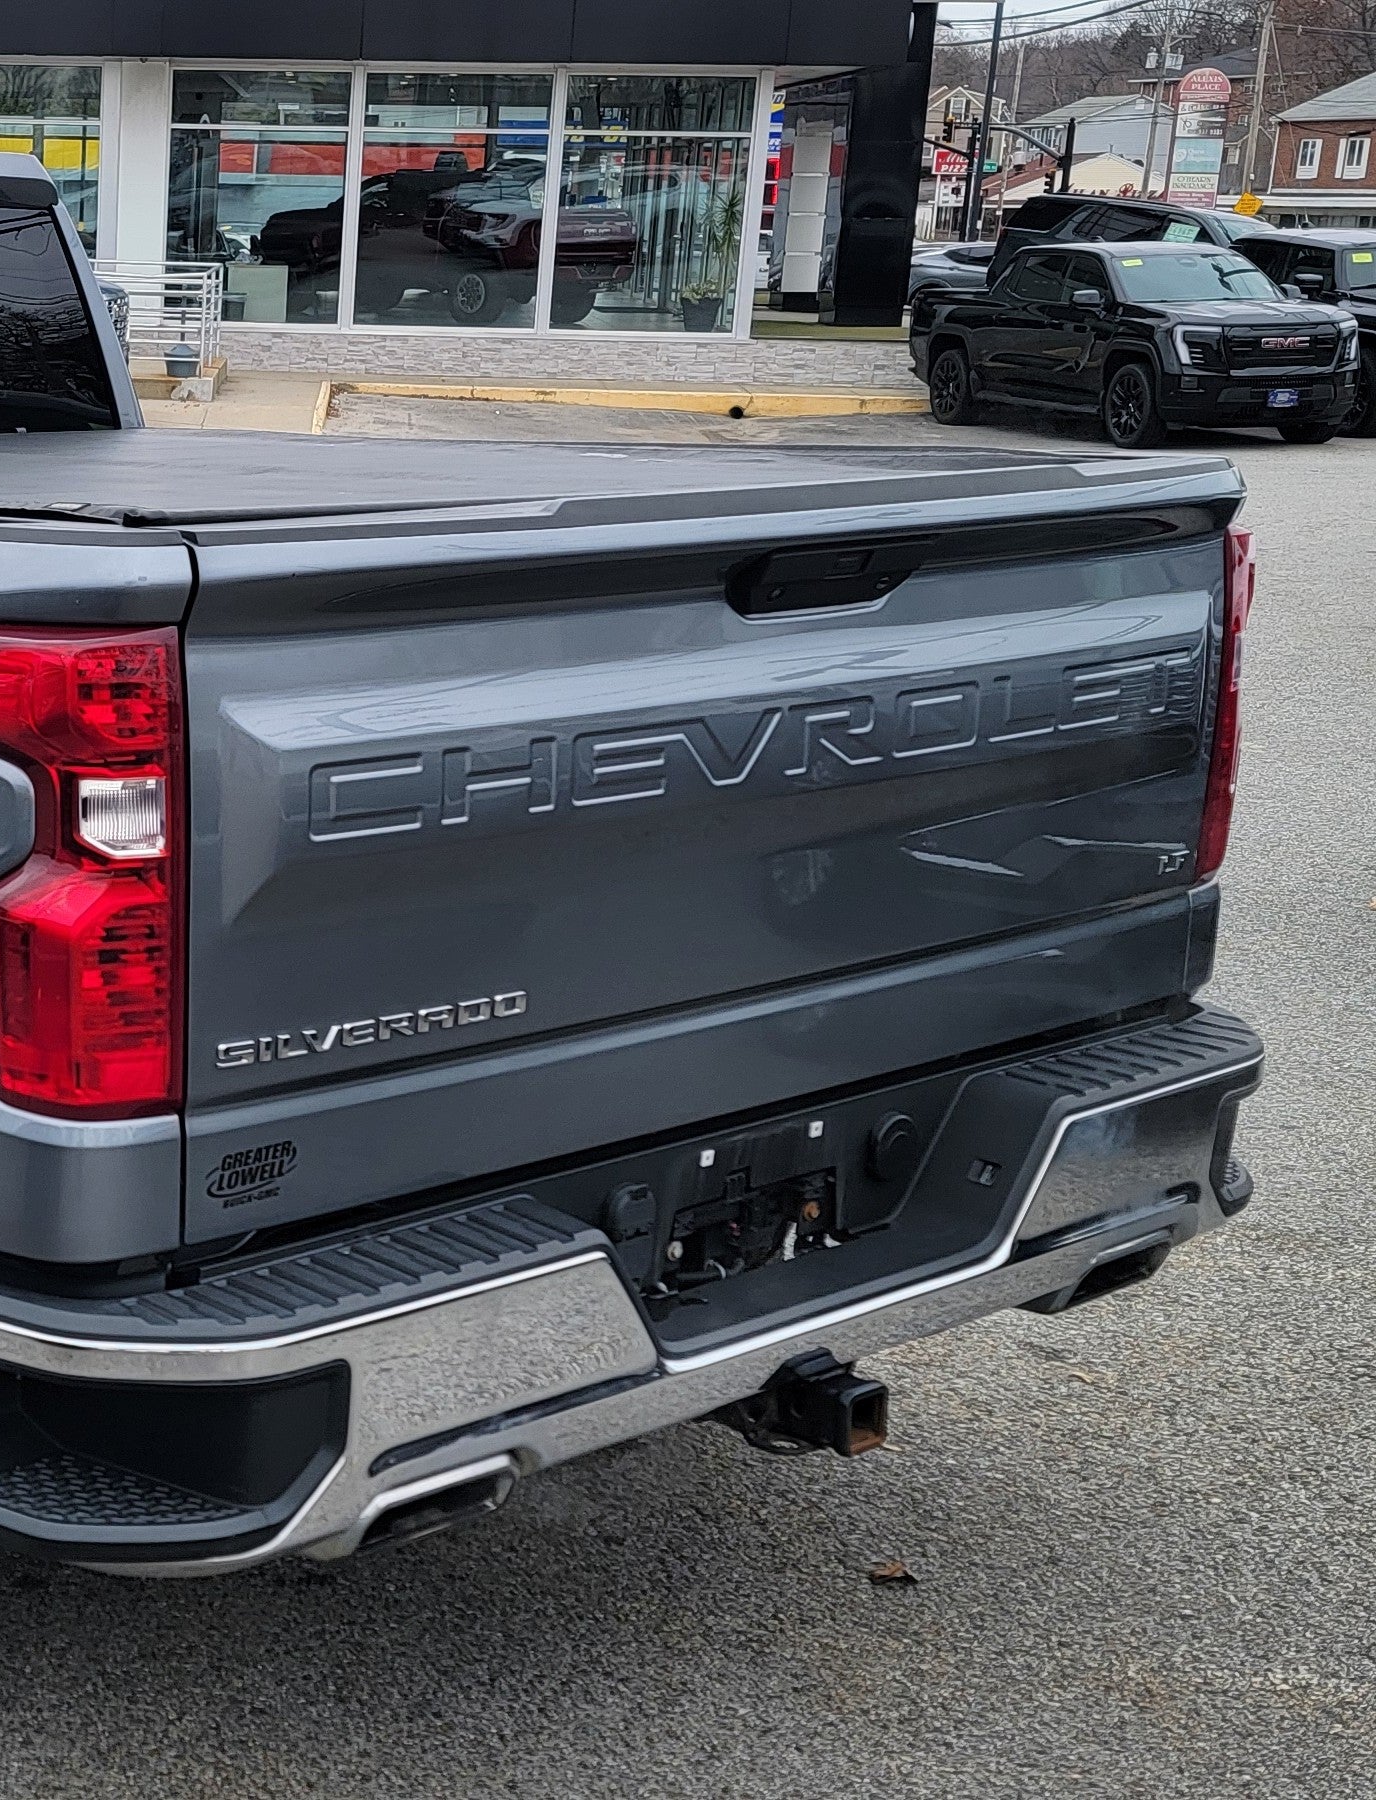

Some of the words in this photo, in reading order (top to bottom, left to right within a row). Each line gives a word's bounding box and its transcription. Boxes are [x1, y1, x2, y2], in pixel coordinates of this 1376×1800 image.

[1191, 83, 1222, 91] PLACE
[1261, 336, 1311, 349] GMC
[308, 647, 1193, 843] CHEVROLET
[1156, 849, 1191, 876] LT
[215, 990, 527, 1069] SILVERADO
[221, 1140, 292, 1171] GREATER
[216, 1159, 285, 1192] LOWELL
